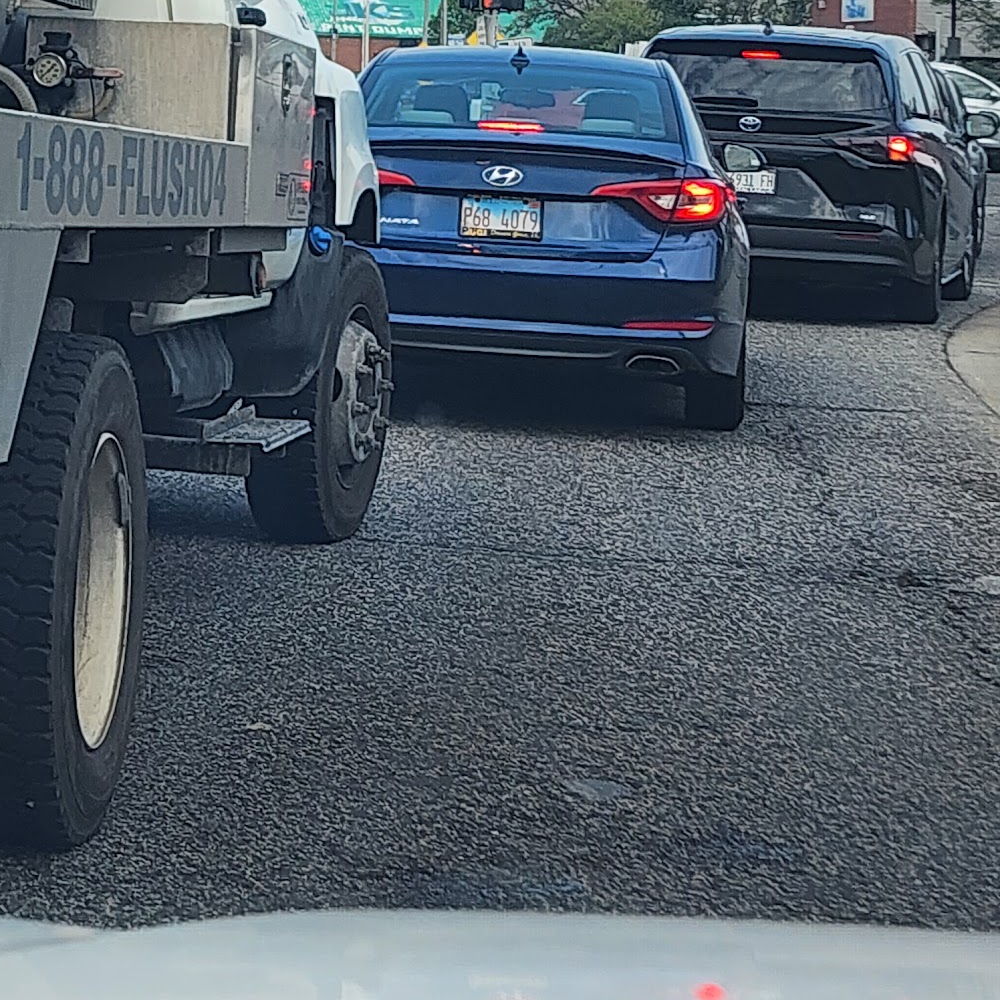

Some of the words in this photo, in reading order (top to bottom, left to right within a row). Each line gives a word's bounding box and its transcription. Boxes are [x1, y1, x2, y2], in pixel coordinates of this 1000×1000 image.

[16, 121, 227, 218] 1-888-FLUSH04
[760, 174, 774, 187] FH
[380, 216, 420, 225] NATA
[463, 206, 491, 228] P68
[501, 208, 539, 231] 4079
